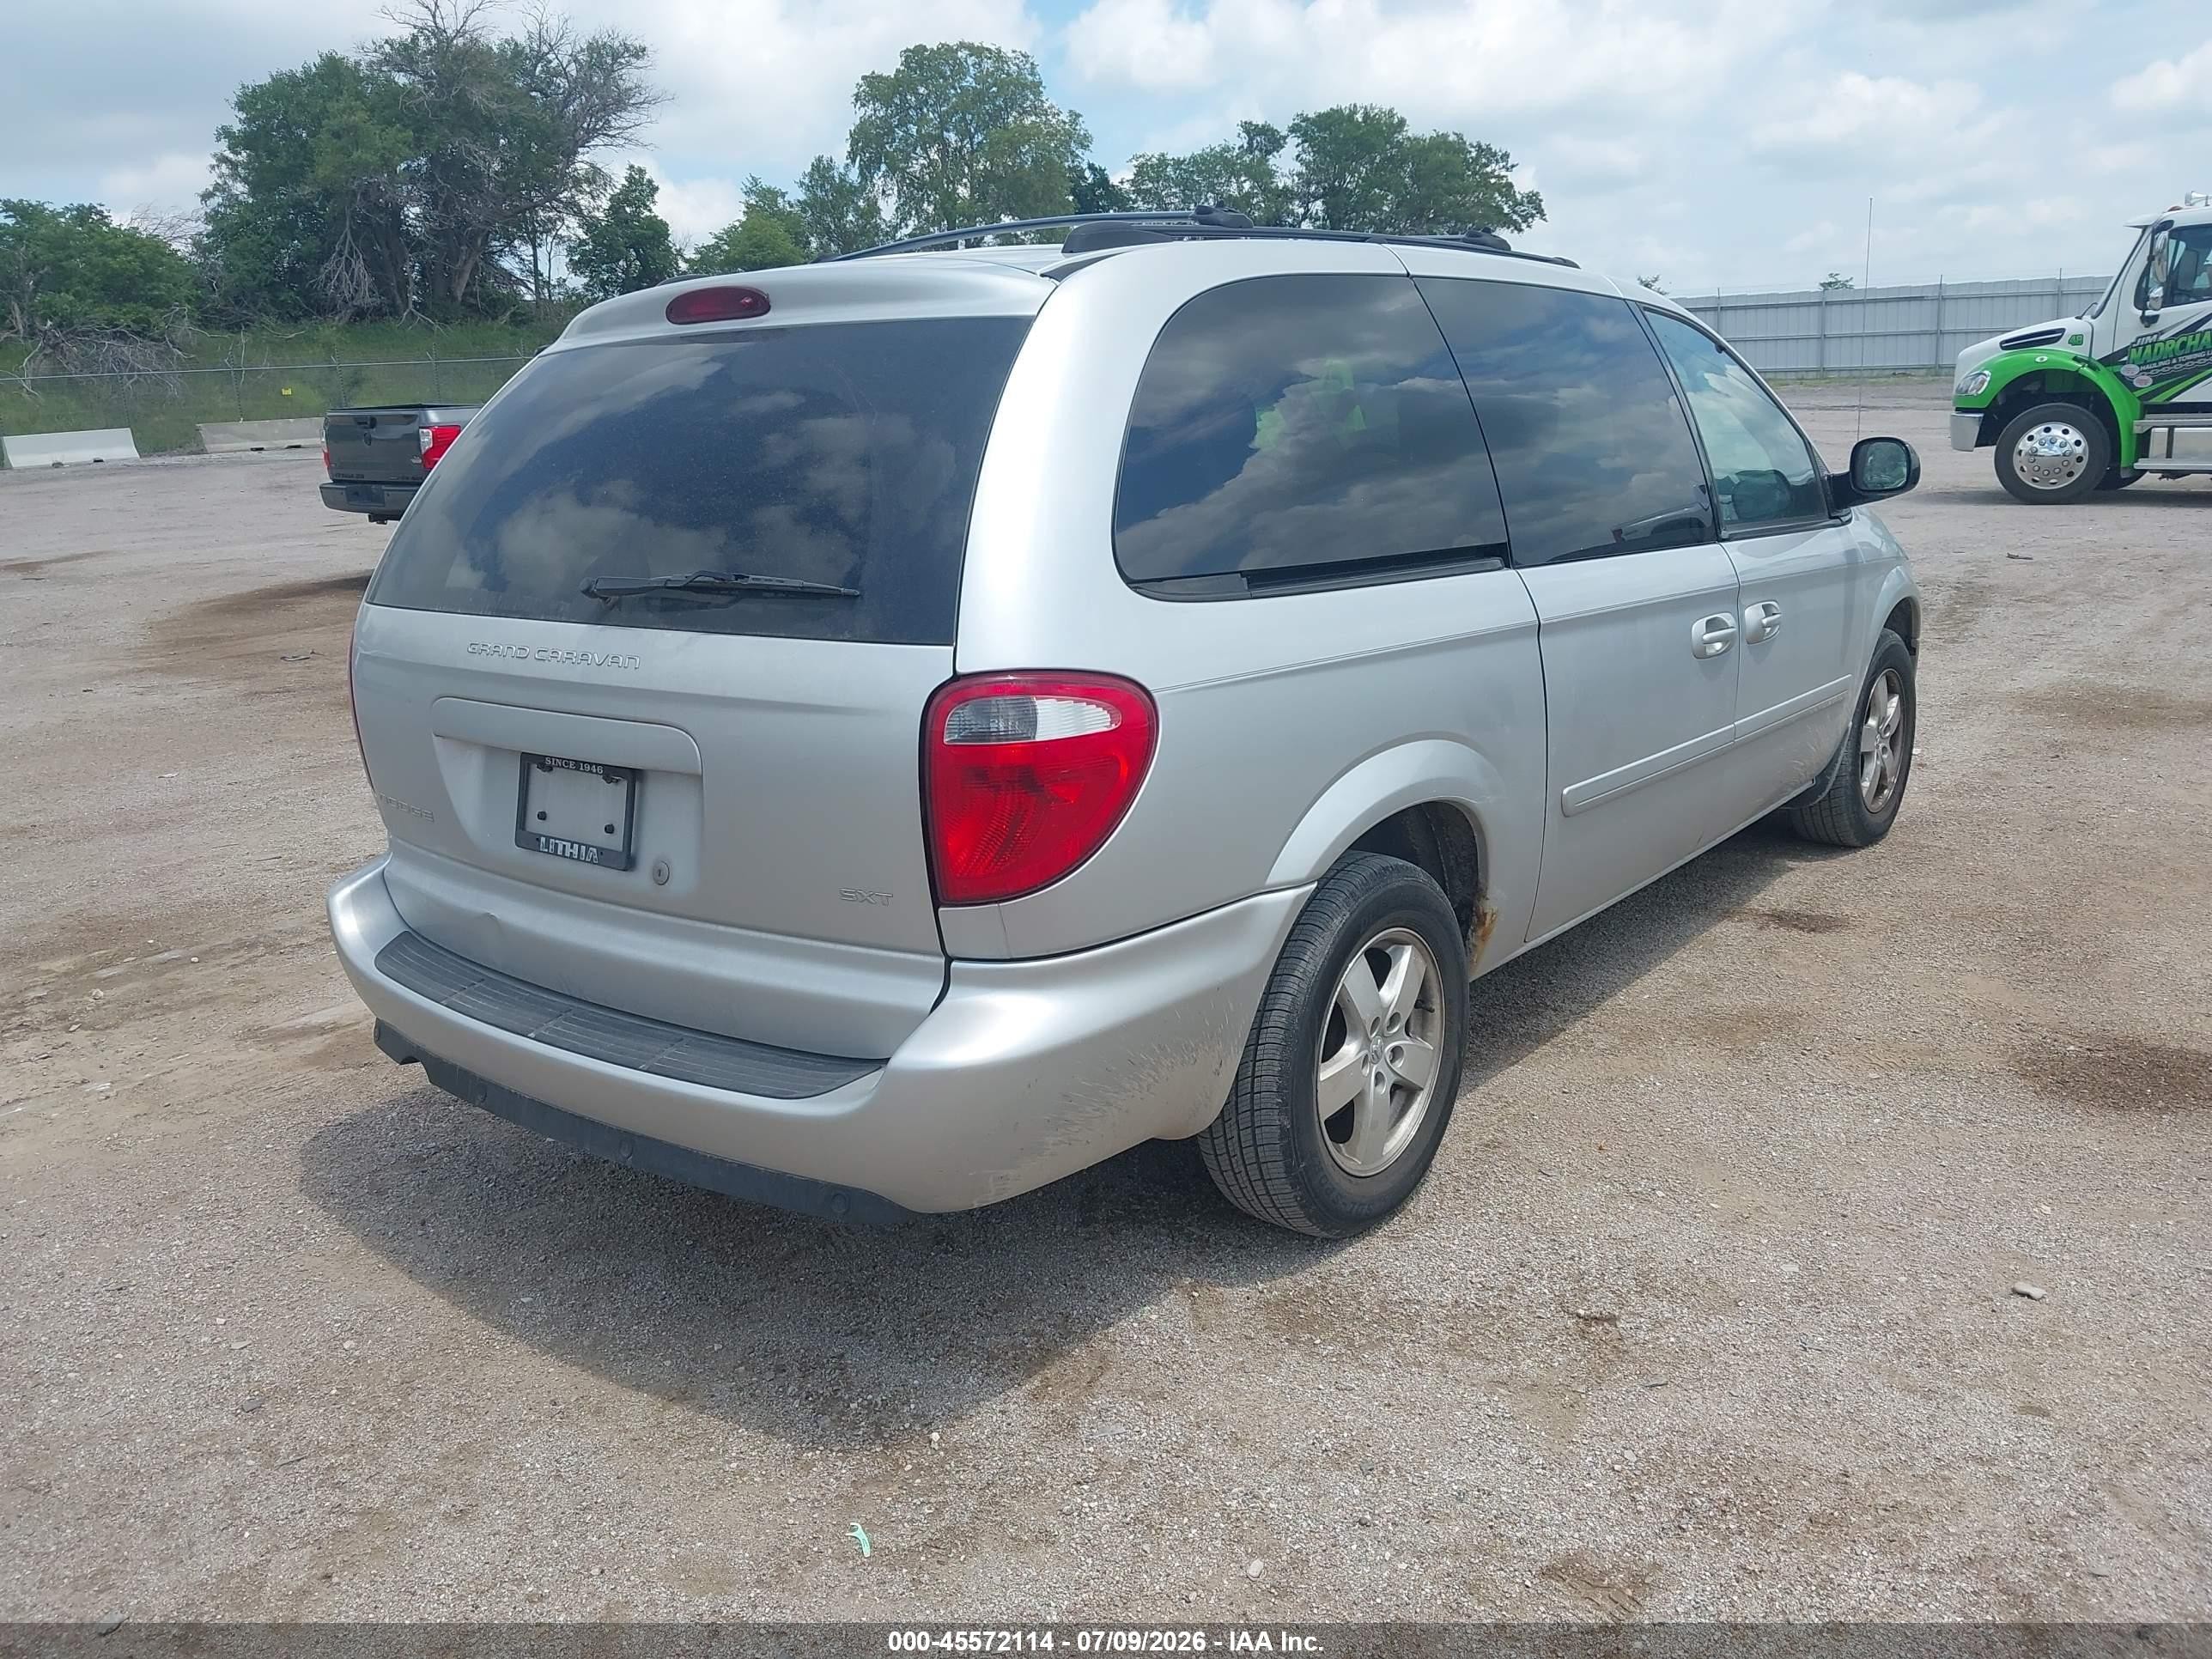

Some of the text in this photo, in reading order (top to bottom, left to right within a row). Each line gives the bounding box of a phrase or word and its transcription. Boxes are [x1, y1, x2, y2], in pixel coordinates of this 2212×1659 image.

[2069, 334, 2083, 345] 48
[2133, 334, 2158, 347] JIM
[2140, 359, 2171, 371] HAULING
[467, 642, 641, 669] GRAND CARAVAN
[545, 757, 604, 774] SINCE 1946
[539, 836, 599, 864] LITHIA
[840, 887, 893, 907] SXT
